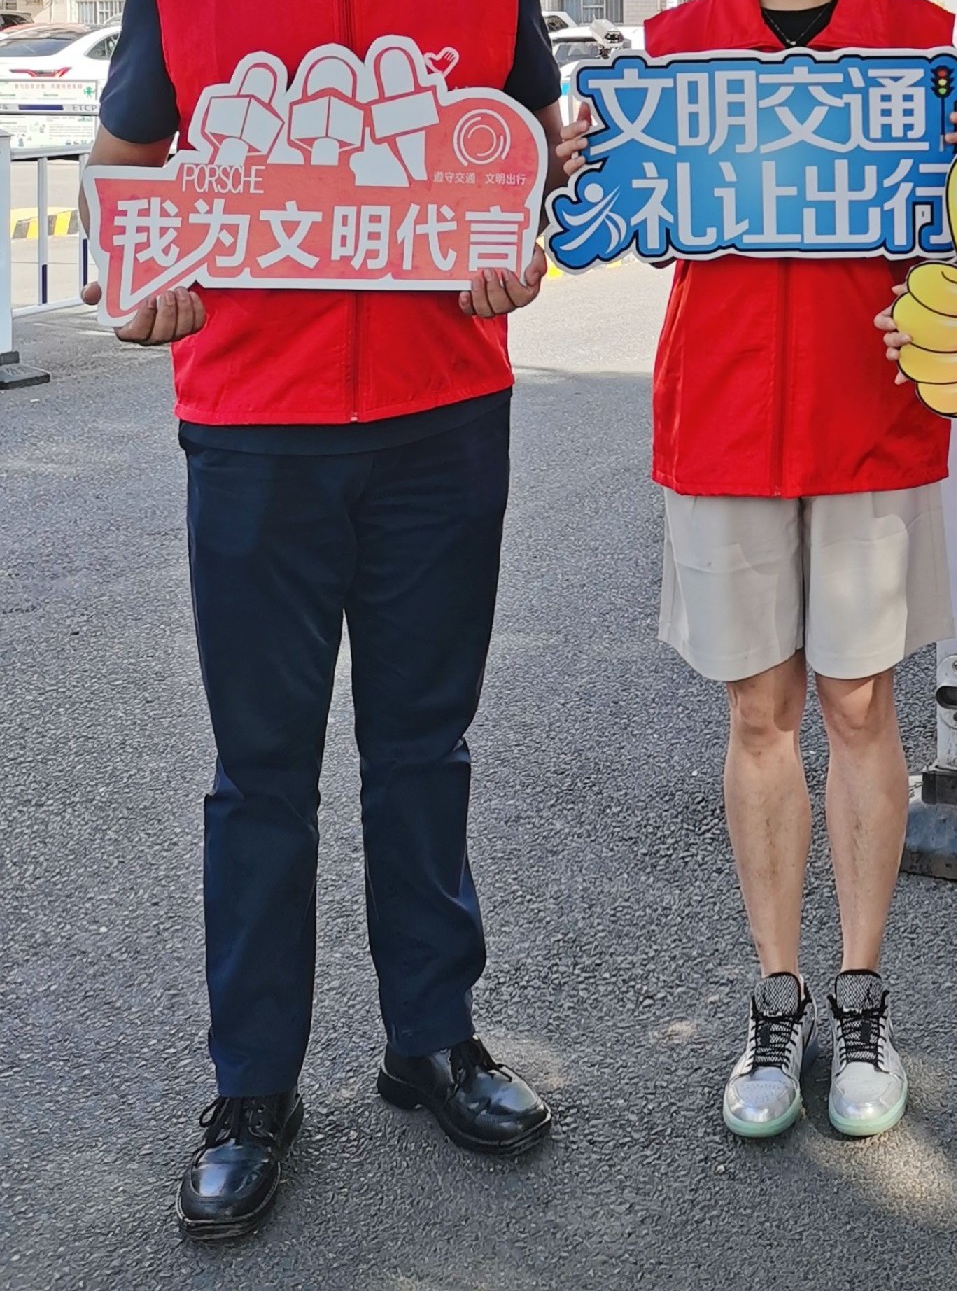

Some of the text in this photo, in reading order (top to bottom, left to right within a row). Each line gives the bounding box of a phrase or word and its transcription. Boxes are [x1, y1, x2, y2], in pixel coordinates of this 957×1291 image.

[588, 67, 929, 155] 文明交通
[182, 165, 265, 193] PORSCHE
[433, 172, 526, 186] 遵守交通 文明出行
[631, 159, 952, 250] 礼让出行
[113, 197, 524, 275] 我为文明代言
